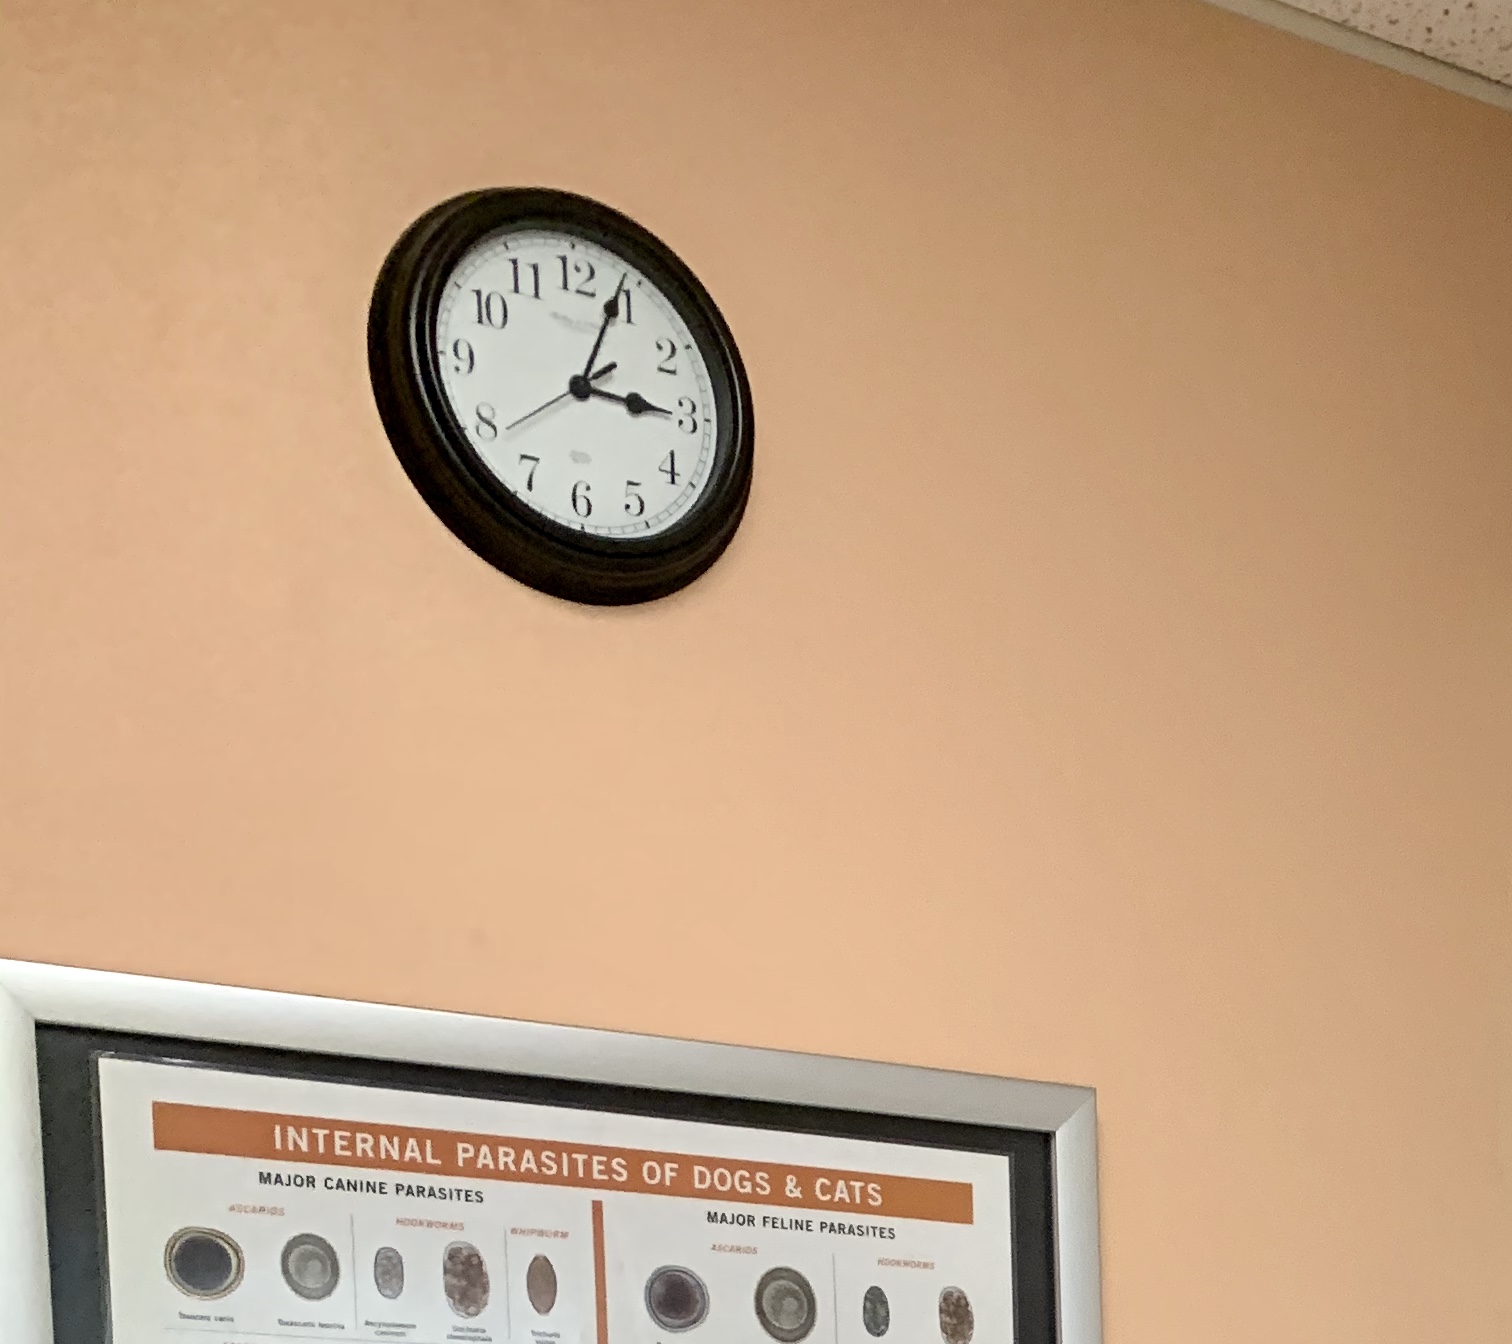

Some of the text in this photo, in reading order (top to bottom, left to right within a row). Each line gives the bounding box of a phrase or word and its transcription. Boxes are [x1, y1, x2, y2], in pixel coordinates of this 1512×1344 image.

[508, 258, 542, 300] 11
[557, 254, 597, 298] 12
[471, 289, 508, 330] 10
[623, 288, 637, 326] 1
[452, 338, 475, 375] 9
[655, 337, 677, 375] 2
[475, 402, 498, 441] 8
[677, 396, 698, 434] 3
[518, 453, 540, 492] 7
[658, 449, 680, 485] 4
[571, 481, 592, 518] 6
[624, 480, 645, 516] 5
[273, 1125, 883, 1207] INTERNAL PARASITES OF DOGS & CATS
[259, 1171, 485, 1204] MAJOR CANINE PARASITES
[707, 1210, 897, 1240] MAJOR FELINE PARASITES
[710, 1243, 759, 1256] ASCARIDS
